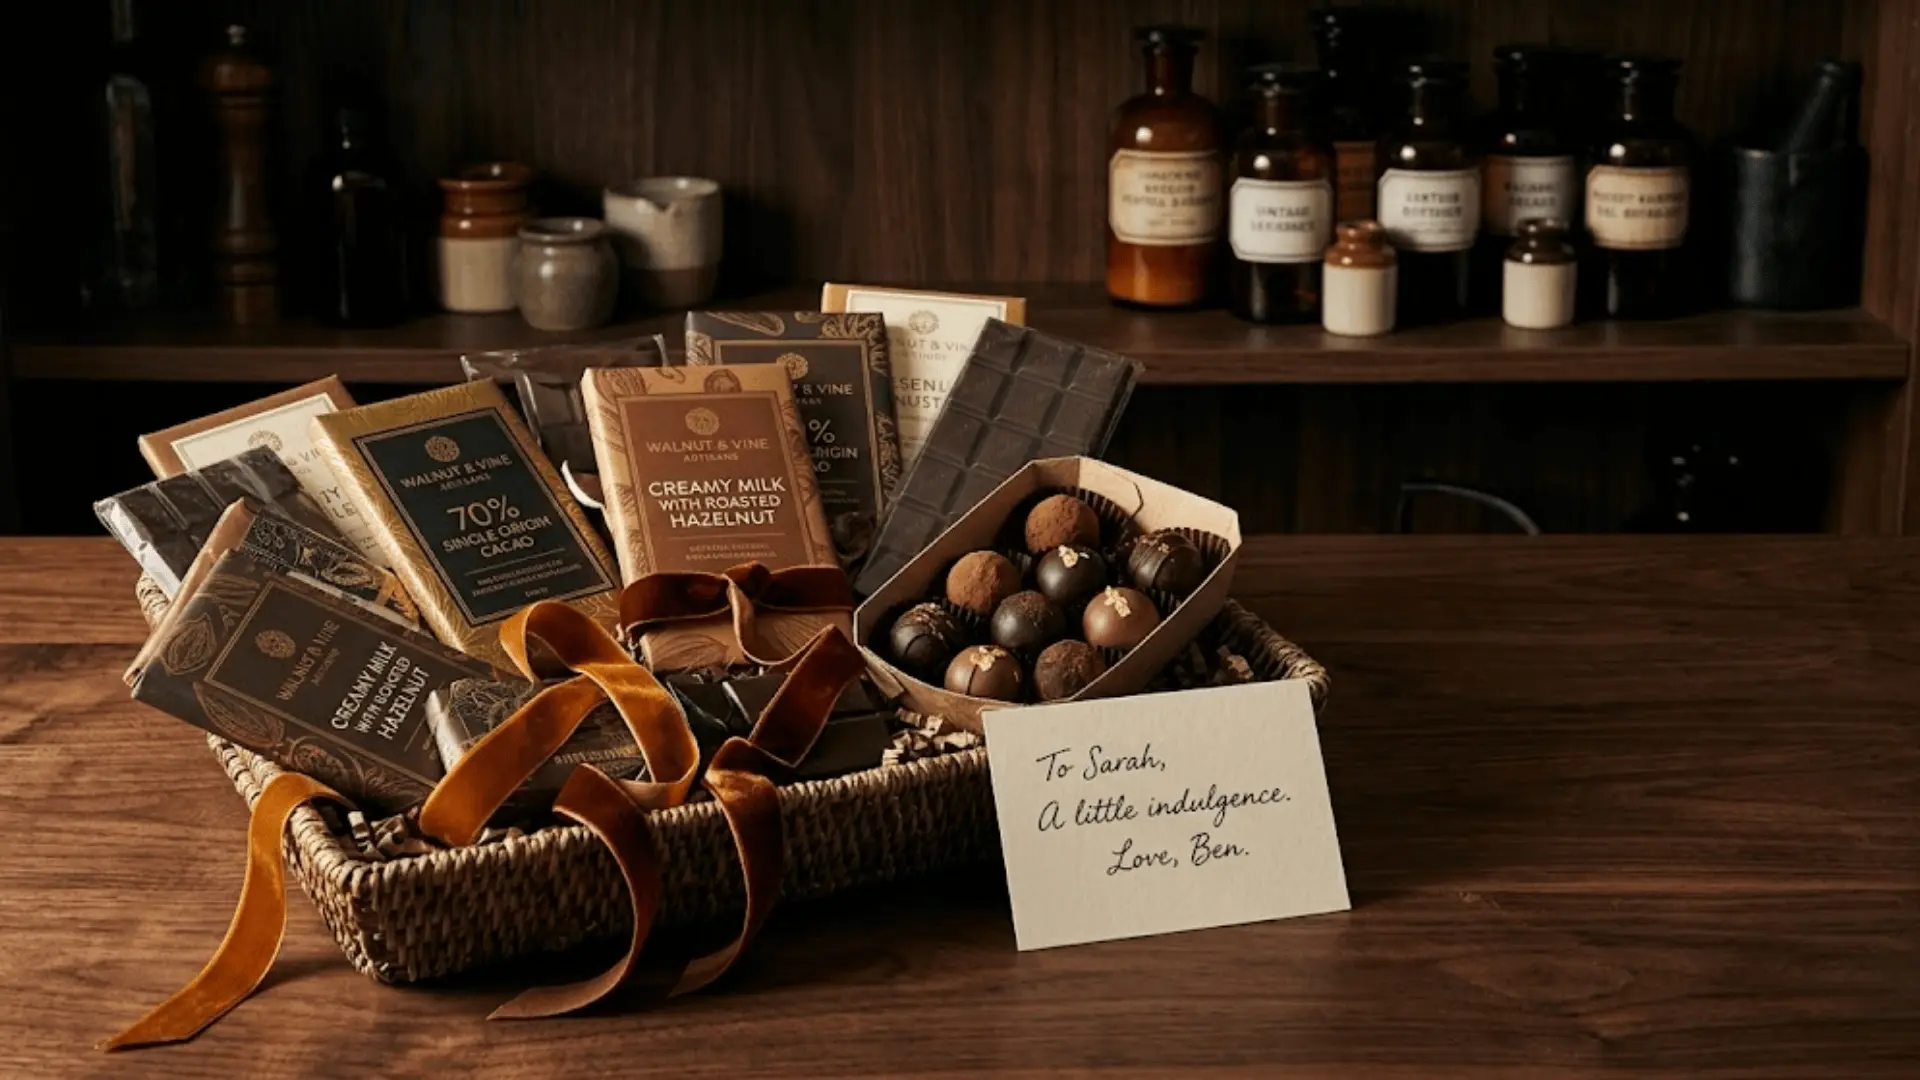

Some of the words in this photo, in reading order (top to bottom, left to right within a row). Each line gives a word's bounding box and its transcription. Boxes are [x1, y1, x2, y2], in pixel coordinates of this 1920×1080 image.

[943, 341, 970, 353] VIN
[816, 383, 853, 395] VINE
[645, 439, 717, 453] WALNUT
[719, 440, 729, 451] &
[731, 438, 770, 451] VINE
[810, 447, 859, 459] RIGIN
[400, 464, 462, 489] WALNUT
[475, 453, 514, 471] VINE
[648, 478, 732, 497] CREAMY
[738, 476, 786, 493] MILK
[446, 494, 521, 532] 70%
[658, 498, 702, 512] WITH
[705, 494, 782, 509] ROASTED
[441, 530, 496, 553] SINGLE
[498, 514, 553, 540] ORIGIN
[669, 509, 776, 529] HAZELNUT
[479, 536, 535, 559] CACAO
[330, 671, 377, 731] CREAMY
[367, 640, 398, 679] MILK
[376, 666, 432, 741] HAZELNUT
[1035, 747, 1074, 783] To
[1082, 743, 1167, 782] Sarah,
[1037, 799, 1066, 832] A
[1074, 794, 1139, 827] little
[1146, 783, 1292, 828] indulgence.
[1106, 838, 1179, 877] Love,
[1190, 832, 1250, 868] Ben.
